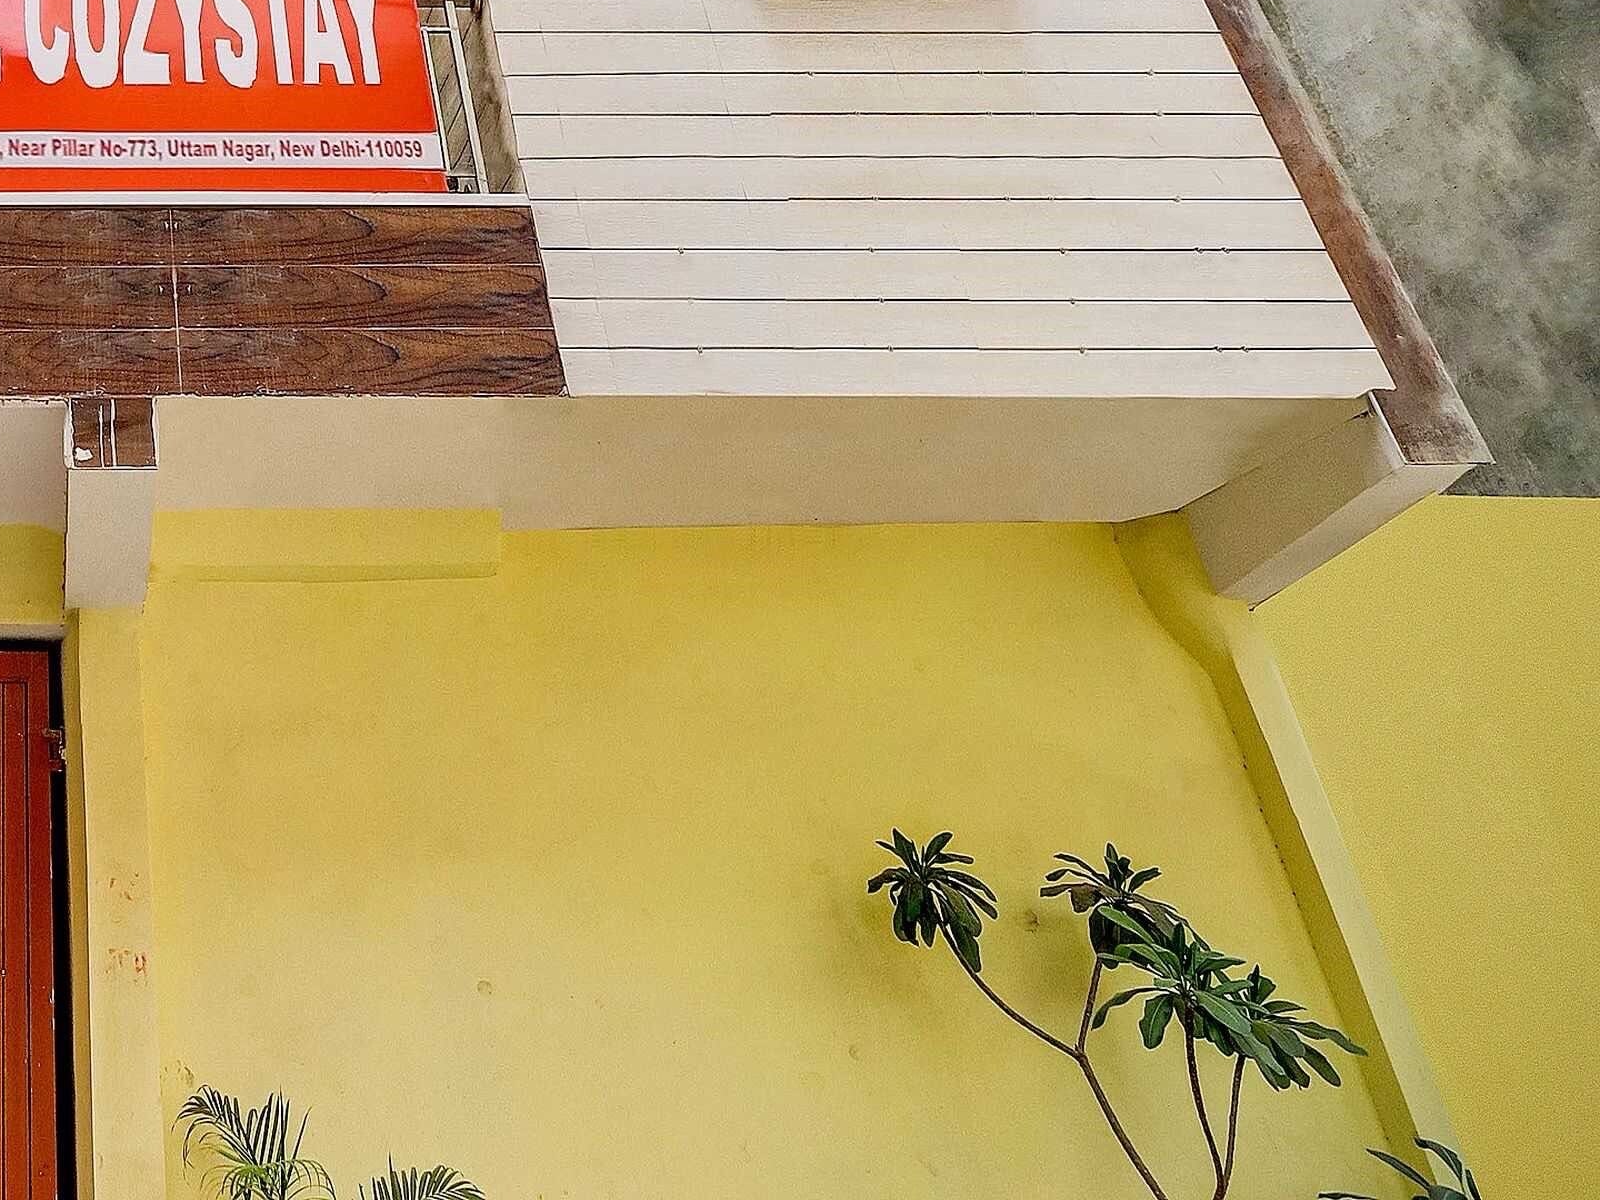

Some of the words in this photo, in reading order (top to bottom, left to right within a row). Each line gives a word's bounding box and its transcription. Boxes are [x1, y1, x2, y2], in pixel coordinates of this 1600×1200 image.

[8, 139, 46, 157] Near
[52, 139, 94, 157] Pillar
[100, 140, 162, 161] No-773,
[168, 140, 217, 158] Uttam
[223, 140, 274, 161] Nagar,
[280, 140, 314, 157] New
[321, 140, 423, 158] Delhi-110059
